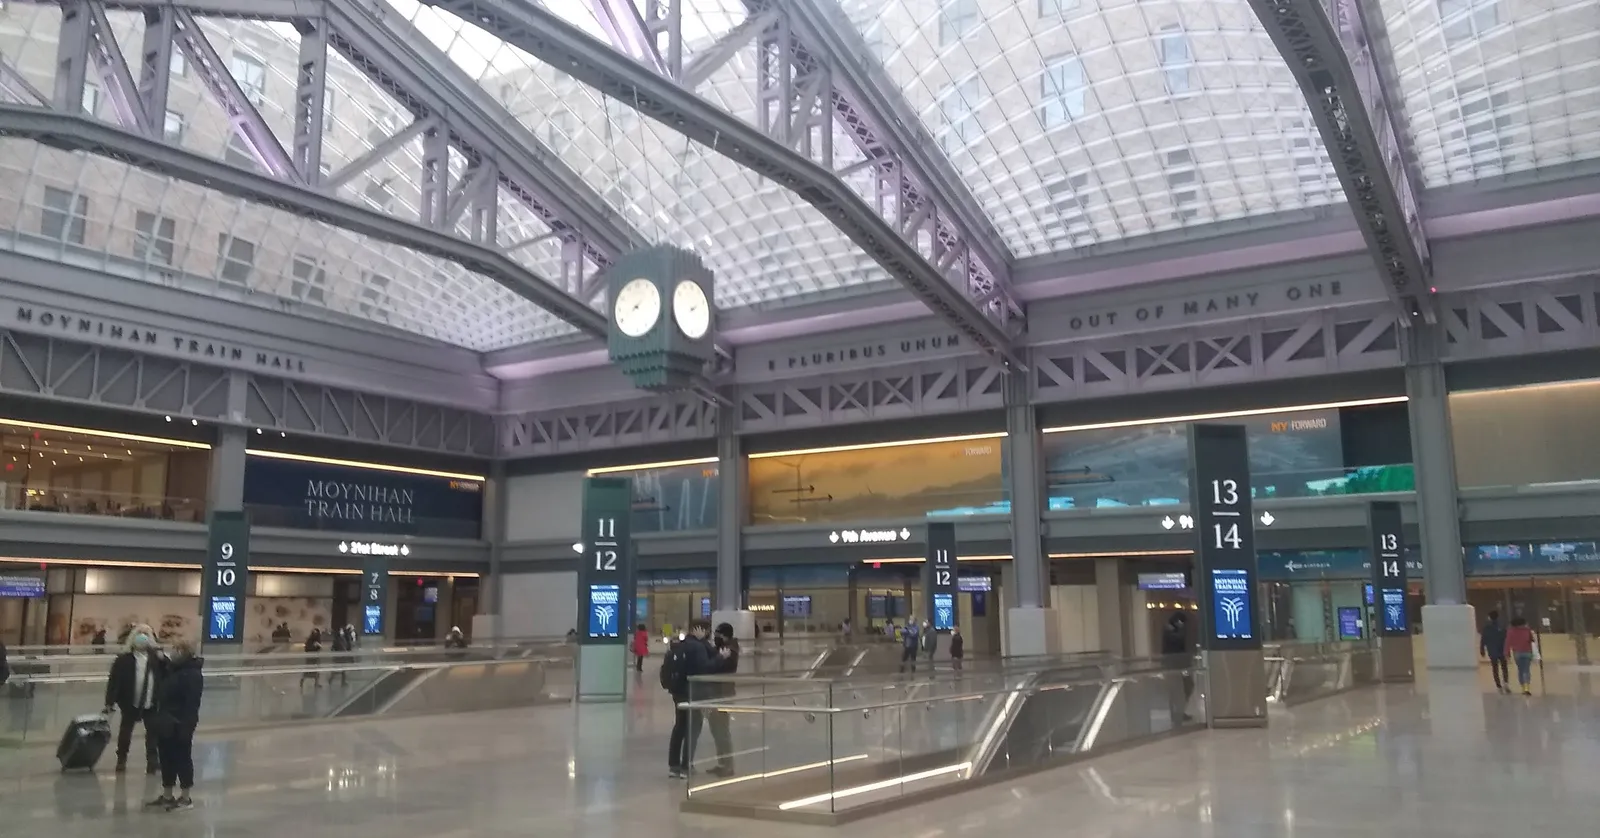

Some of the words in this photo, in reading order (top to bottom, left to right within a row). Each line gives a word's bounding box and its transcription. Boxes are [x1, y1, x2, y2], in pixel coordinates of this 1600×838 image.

[1069, 311, 1118, 331] OUT
[1136, 305, 1164, 322] OF
[1183, 291, 1259, 316] MANY
[1285, 280, 1343, 302] ONE
[16, 306, 157, 345] MOYNIHAN
[173, 335, 242, 361] TRAIN
[256, 352, 306, 374] HALL
[768, 359, 776, 371] E
[788, 344, 886, 369] PLURIBUS
[900, 334, 960, 353] UNUM
[1271, 421, 1289, 432] NY
[1291, 418, 1327, 431] FORWARD
[307, 479, 415, 505] MOYNIHAN
[1211, 478, 1239, 505] 13
[304, 499, 365, 521] TRAIN
[370, 504, 415, 524] HALL
[598, 518, 616, 538] 11
[860, 529, 897, 543] Avenue
[1212, 522, 1243, 549] 14
[221, 542, 234, 560] 9
[1380, 533, 1398, 551] 13
[594, 550, 618, 571] 12
[936, 549, 949, 564] 11
[216, 568, 237, 587] 10
[371, 572, 379, 584] 7
[936, 570, 951, 586] 12
[1381, 560, 1401, 577] 14
[370, 588, 379, 600] 8
